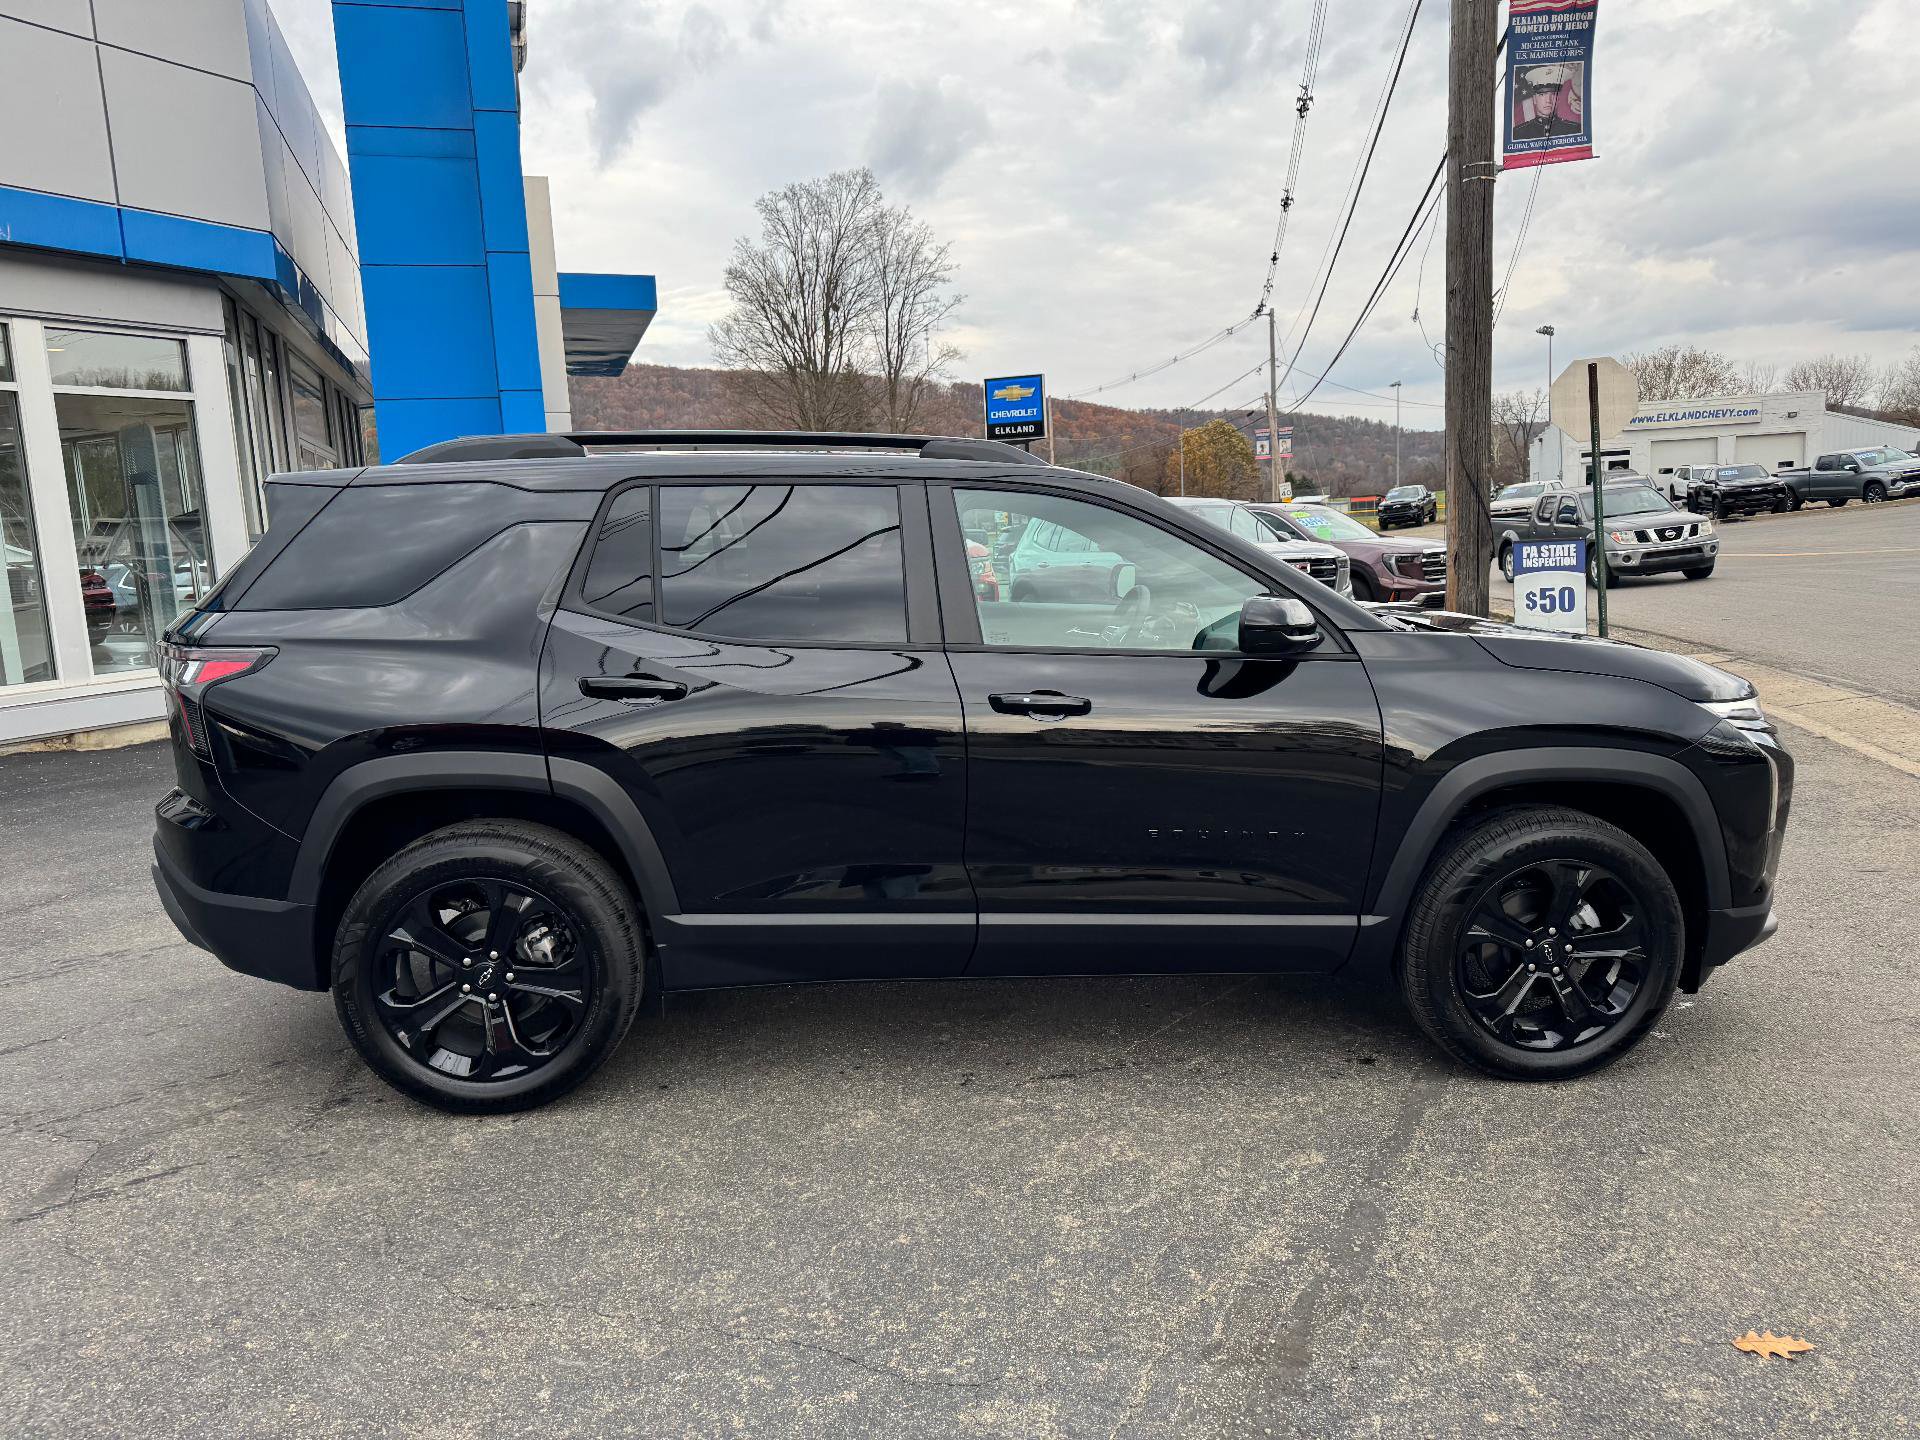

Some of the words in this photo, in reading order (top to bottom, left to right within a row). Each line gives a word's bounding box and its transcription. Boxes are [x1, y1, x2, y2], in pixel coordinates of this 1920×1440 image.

[1512, 15, 1548, 26] ELKLAND
[1551, 12, 1594, 23] BOROUGH
[1515, 23, 1563, 34] HOMETOWN
[1565, 21, 1589, 31] HERO
[1521, 41, 1554, 50] MICHAEL
[1555, 40, 1579, 48] PLANK
[1530, 50, 1559, 59] MARINE
[1560, 48, 1584, 58] CORPS
[1507, 142, 1530, 150] GLOBAL
[1543, 139, 1552, 147] ON
[991, 408, 1037, 418] CHEVROLET
[1630, 408, 1758, 424] www.ELKLANDCHEVY.com
[995, 425, 1035, 435] ELKLAND
[1522, 545, 1538, 559] PA
[1540, 544, 1577, 558] STATE
[1522, 557, 1577, 568] INSPECTION
[1525, 586, 1575, 613] $50
